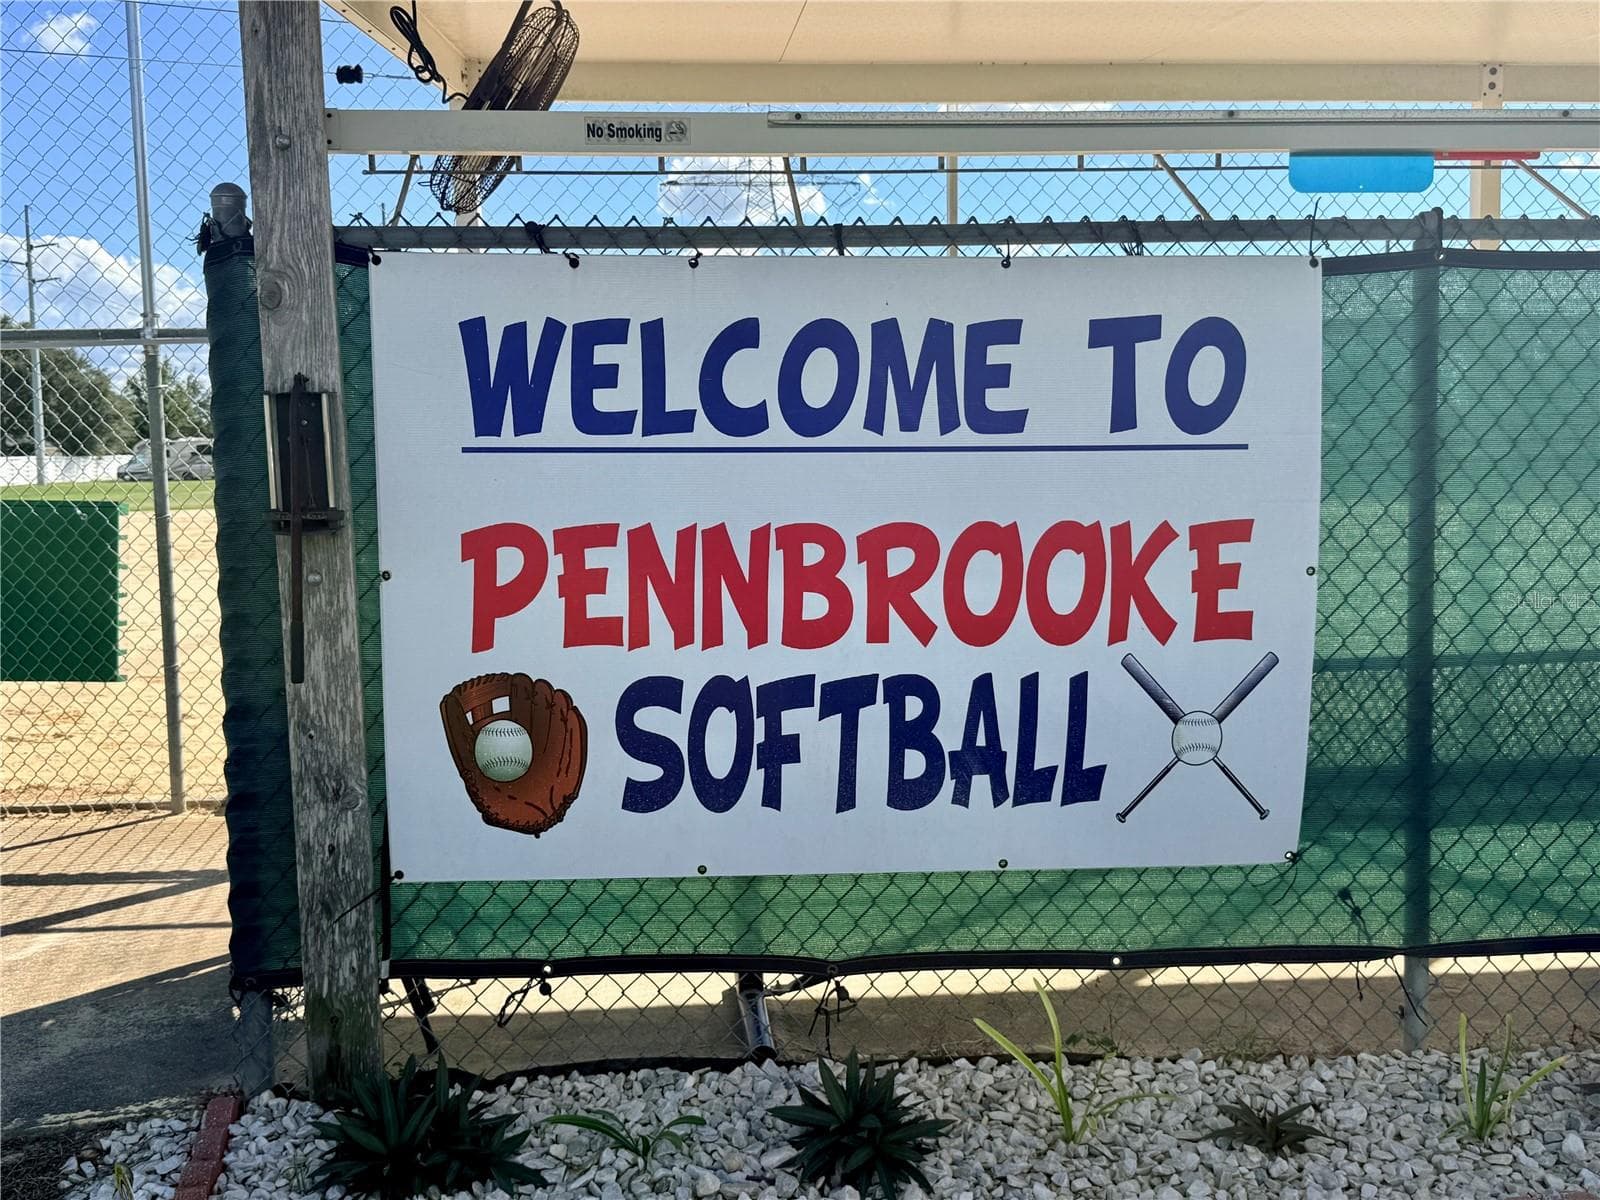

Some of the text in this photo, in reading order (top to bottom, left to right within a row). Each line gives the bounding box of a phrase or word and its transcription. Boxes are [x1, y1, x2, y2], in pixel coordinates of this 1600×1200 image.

[586, 122, 662, 142] No Smoking
[459, 315, 1247, 438] WELCOME TO
[462, 520, 1253, 652] PENNBROOKE
[616, 671, 1107, 813] SOFTBALL
